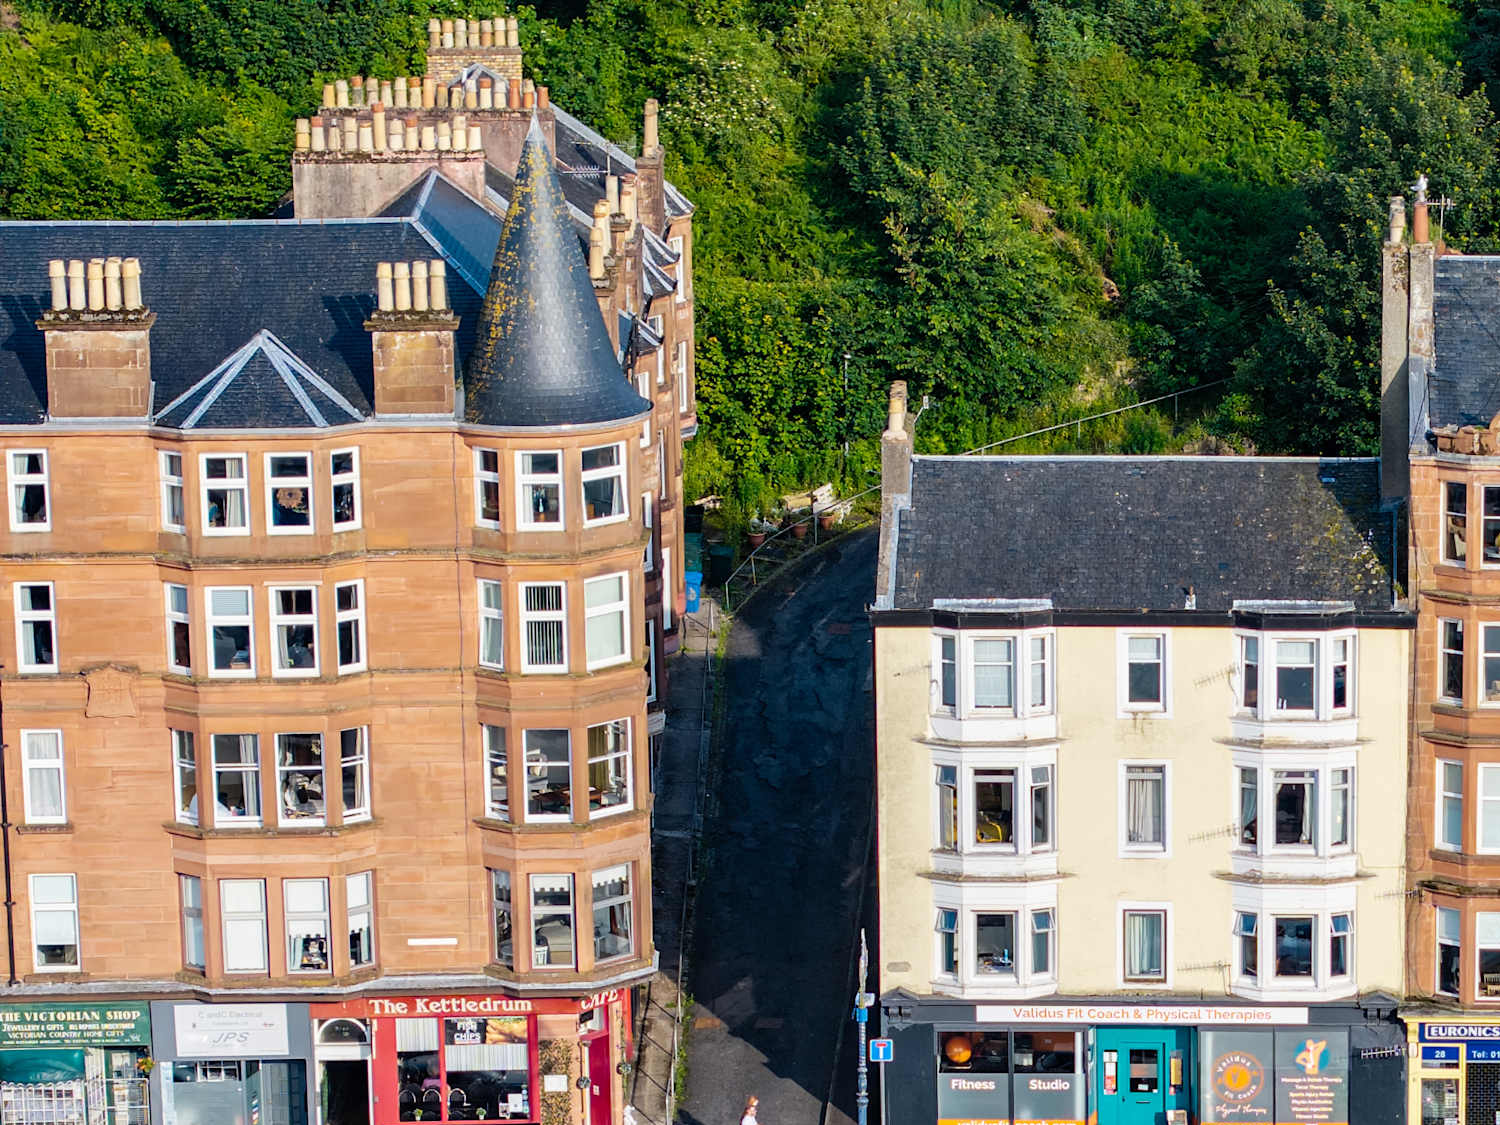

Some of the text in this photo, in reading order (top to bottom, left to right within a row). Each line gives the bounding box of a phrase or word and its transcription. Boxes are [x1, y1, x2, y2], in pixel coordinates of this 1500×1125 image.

[369, 998, 532, 1015] The Kettledrum
[24, 1011, 100, 1022] VICTORIAN
[106, 1010, 141, 1020] SHOP
[1012, 1007, 1272, 1022] Validus Fit Coach & Physical Therapies
[457, 1021, 478, 1031] FISH
[454, 1033, 481, 1041] CHIPS
[1434, 1050, 1446, 1058] 28
[951, 1079, 996, 1090] Fitness
[1029, 1079, 1070, 1090] Studio
